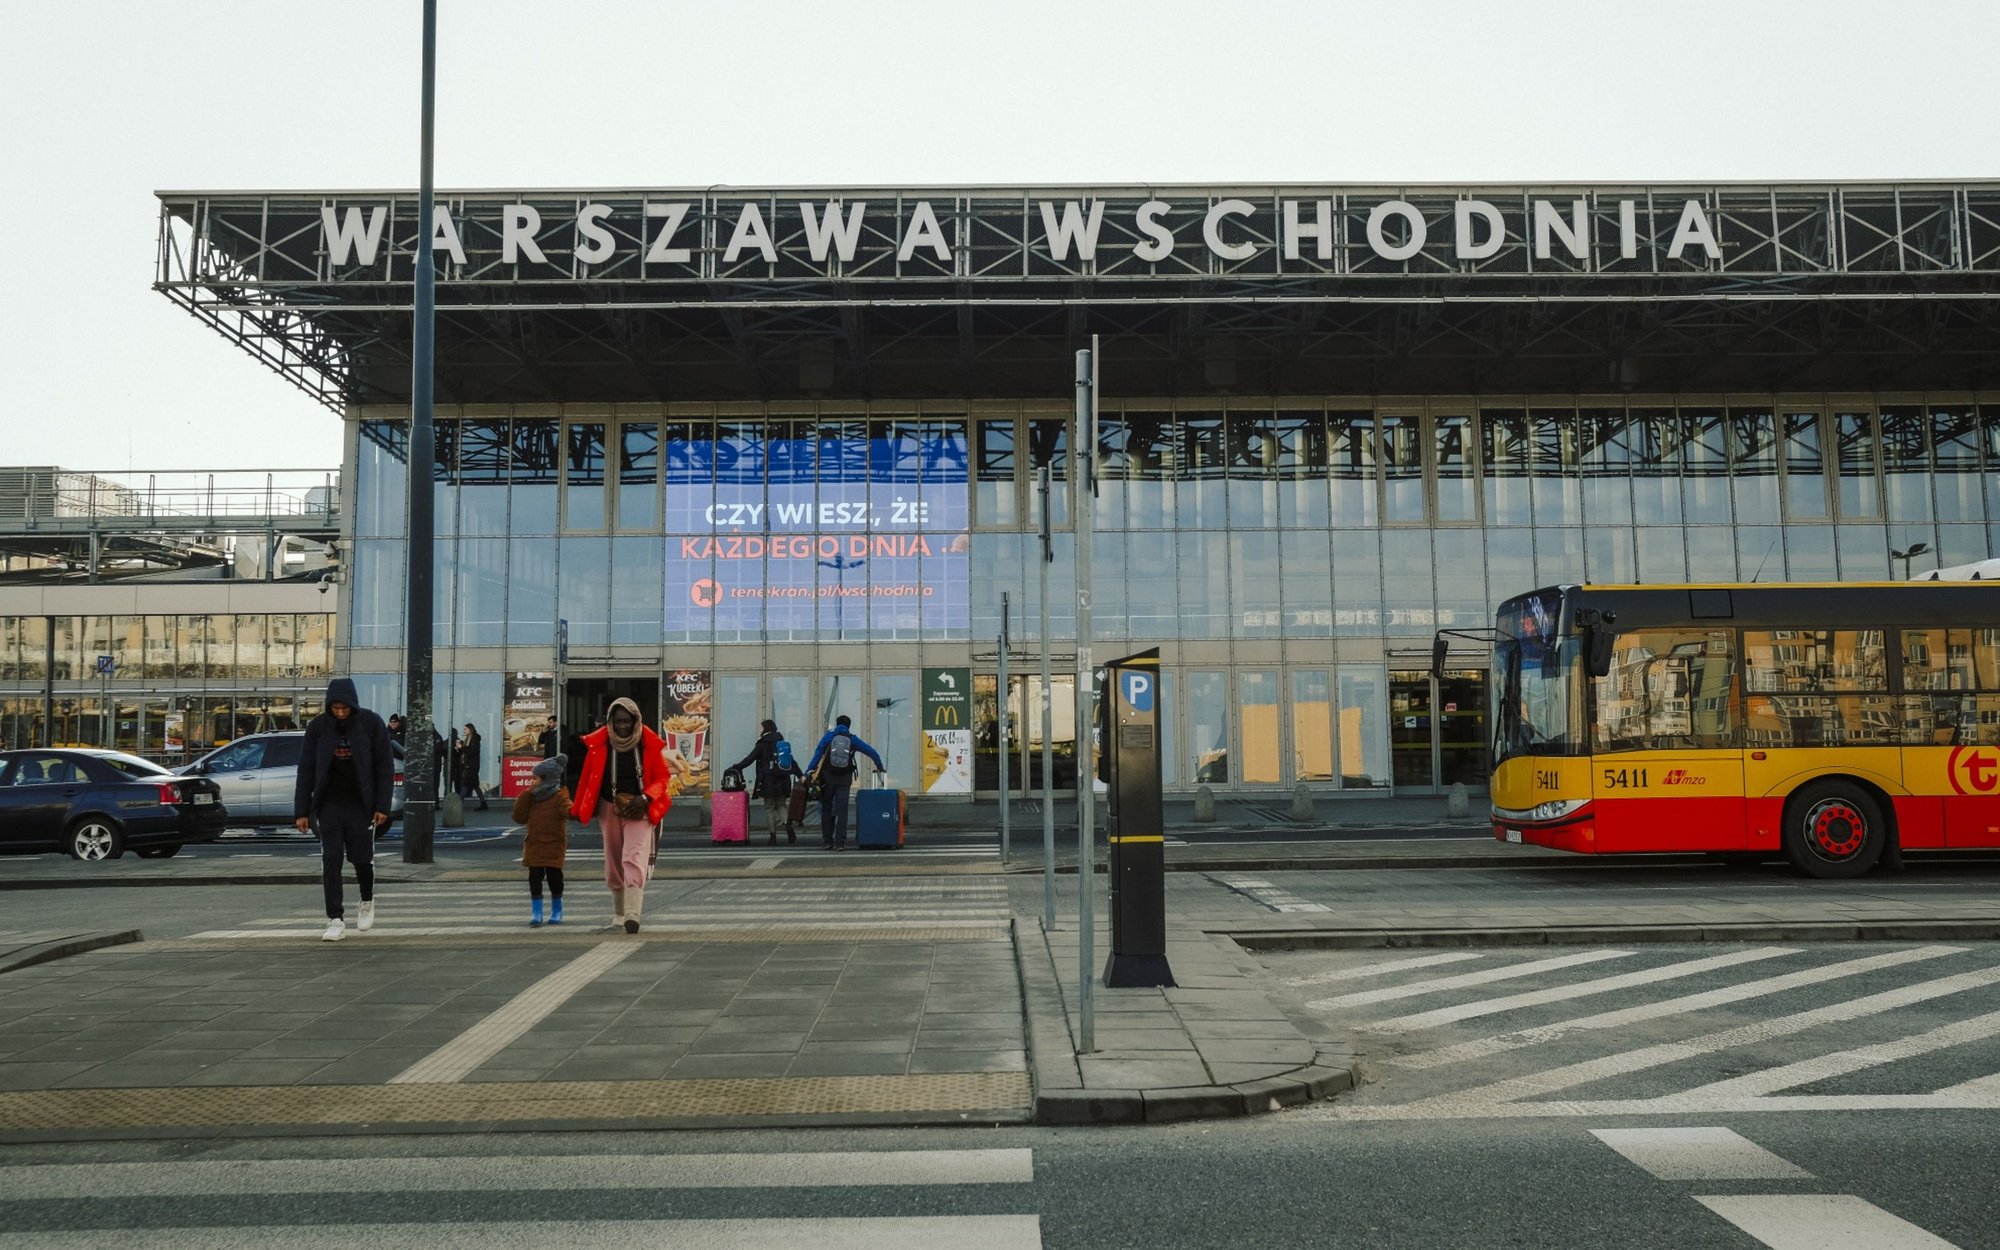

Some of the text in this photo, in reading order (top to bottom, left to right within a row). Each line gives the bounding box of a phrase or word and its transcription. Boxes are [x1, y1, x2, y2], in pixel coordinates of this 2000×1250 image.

[320, 199, 1722, 266] WARSZAWA WSCHODNIA
[705, 496, 928, 526] CZY WIESZ, ŻE
[681, 527, 932, 559] KAŻDEGO DNIA
[516, 687, 542, 697] KFC
[1130, 676, 1148, 704] P
[1537, 771, 1559, 790] 5411
[1604, 769, 1649, 788] 5411
